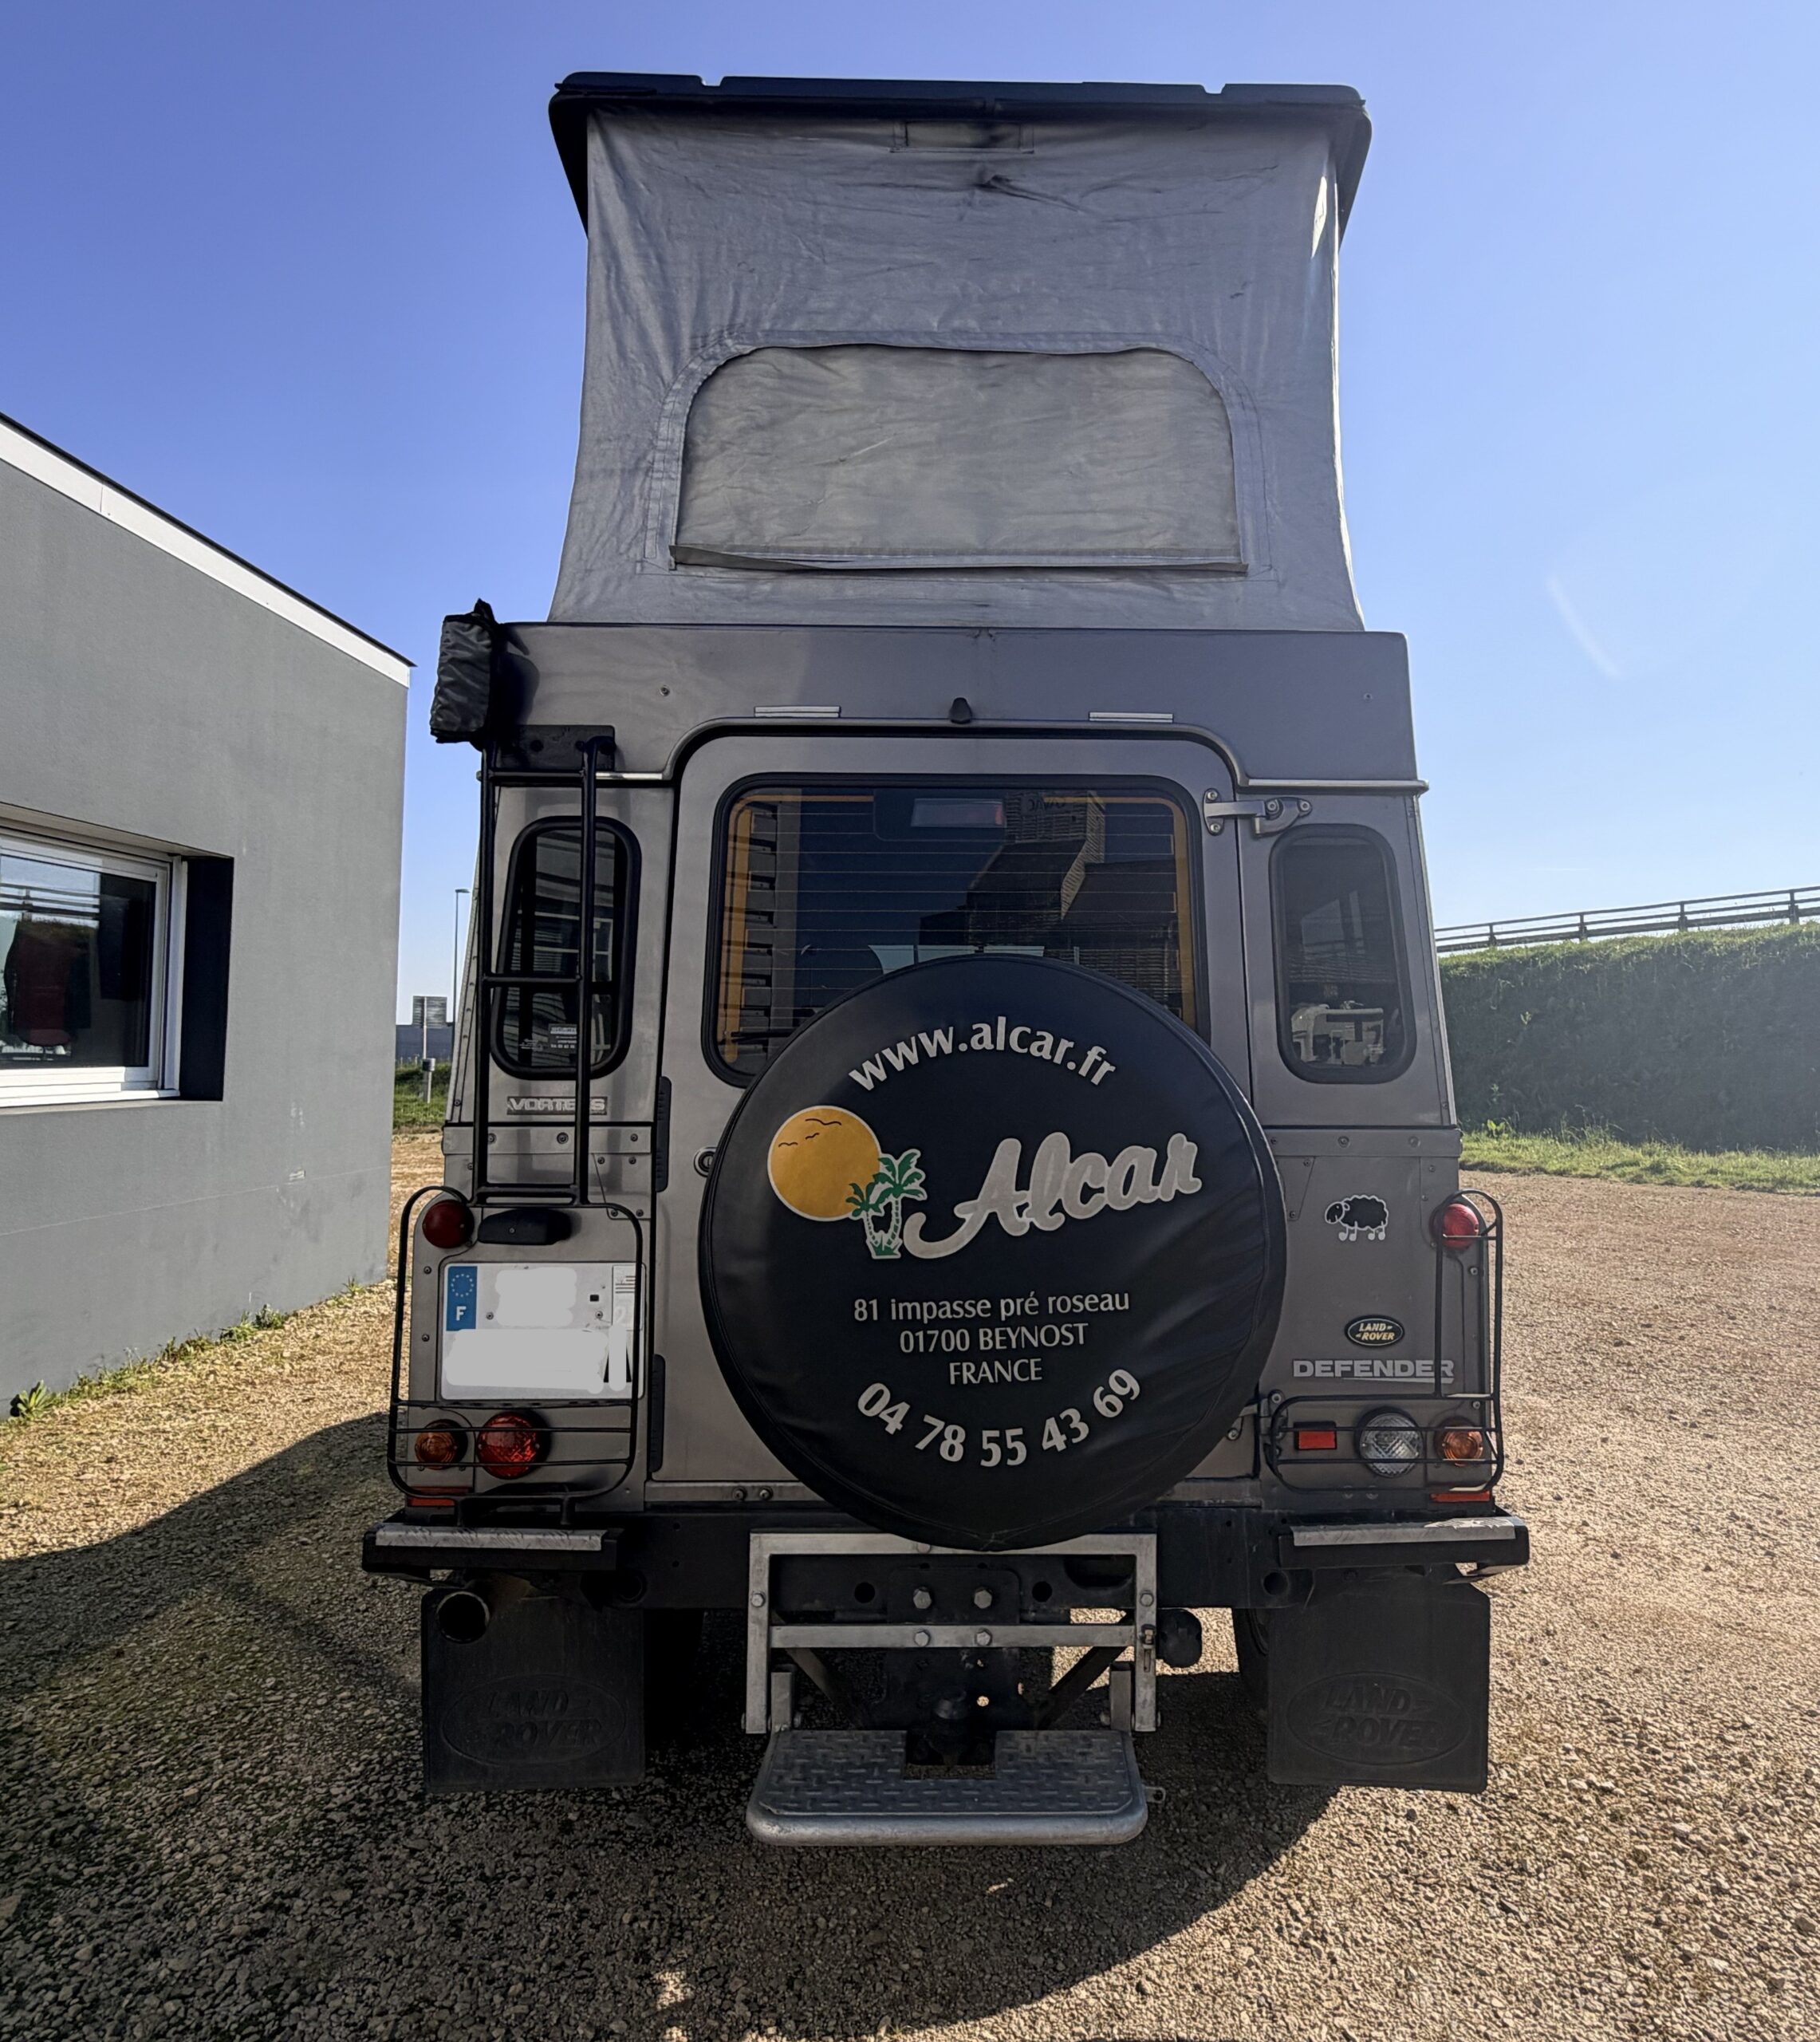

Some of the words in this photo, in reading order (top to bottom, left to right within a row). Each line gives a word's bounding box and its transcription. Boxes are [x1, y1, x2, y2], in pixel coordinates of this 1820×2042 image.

[848, 1015, 1116, 1090] www.alcar.fr
[509, 1097, 606, 1111] VORTES
[903, 1132, 1203, 1259] Alcar
[456, 1306, 467, 1321] F
[854, 1299, 878, 1321] 81
[891, 1299, 991, 1324] impasse
[1000, 1290, 1039, 1321] pré
[1048, 1293, 1130, 1315] roseau
[900, 1329, 970, 1353] 01700
[978, 1323, 1089, 1350] BEYNOST
[1358, 1323, 1386, 1332] LAND
[1361, 1332, 1395, 1341] ROVER
[948, 1358, 1043, 1386] FRANCE
[1293, 1359, 1455, 1378] DEFENDER
[857, 1382, 911, 1435] 04
[914, 1414, 967, 1462] 78
[979, 1428, 1027, 1467] 55
[1041, 1407, 1089, 1453] 43
[1093, 1368, 1140, 1418] 69
